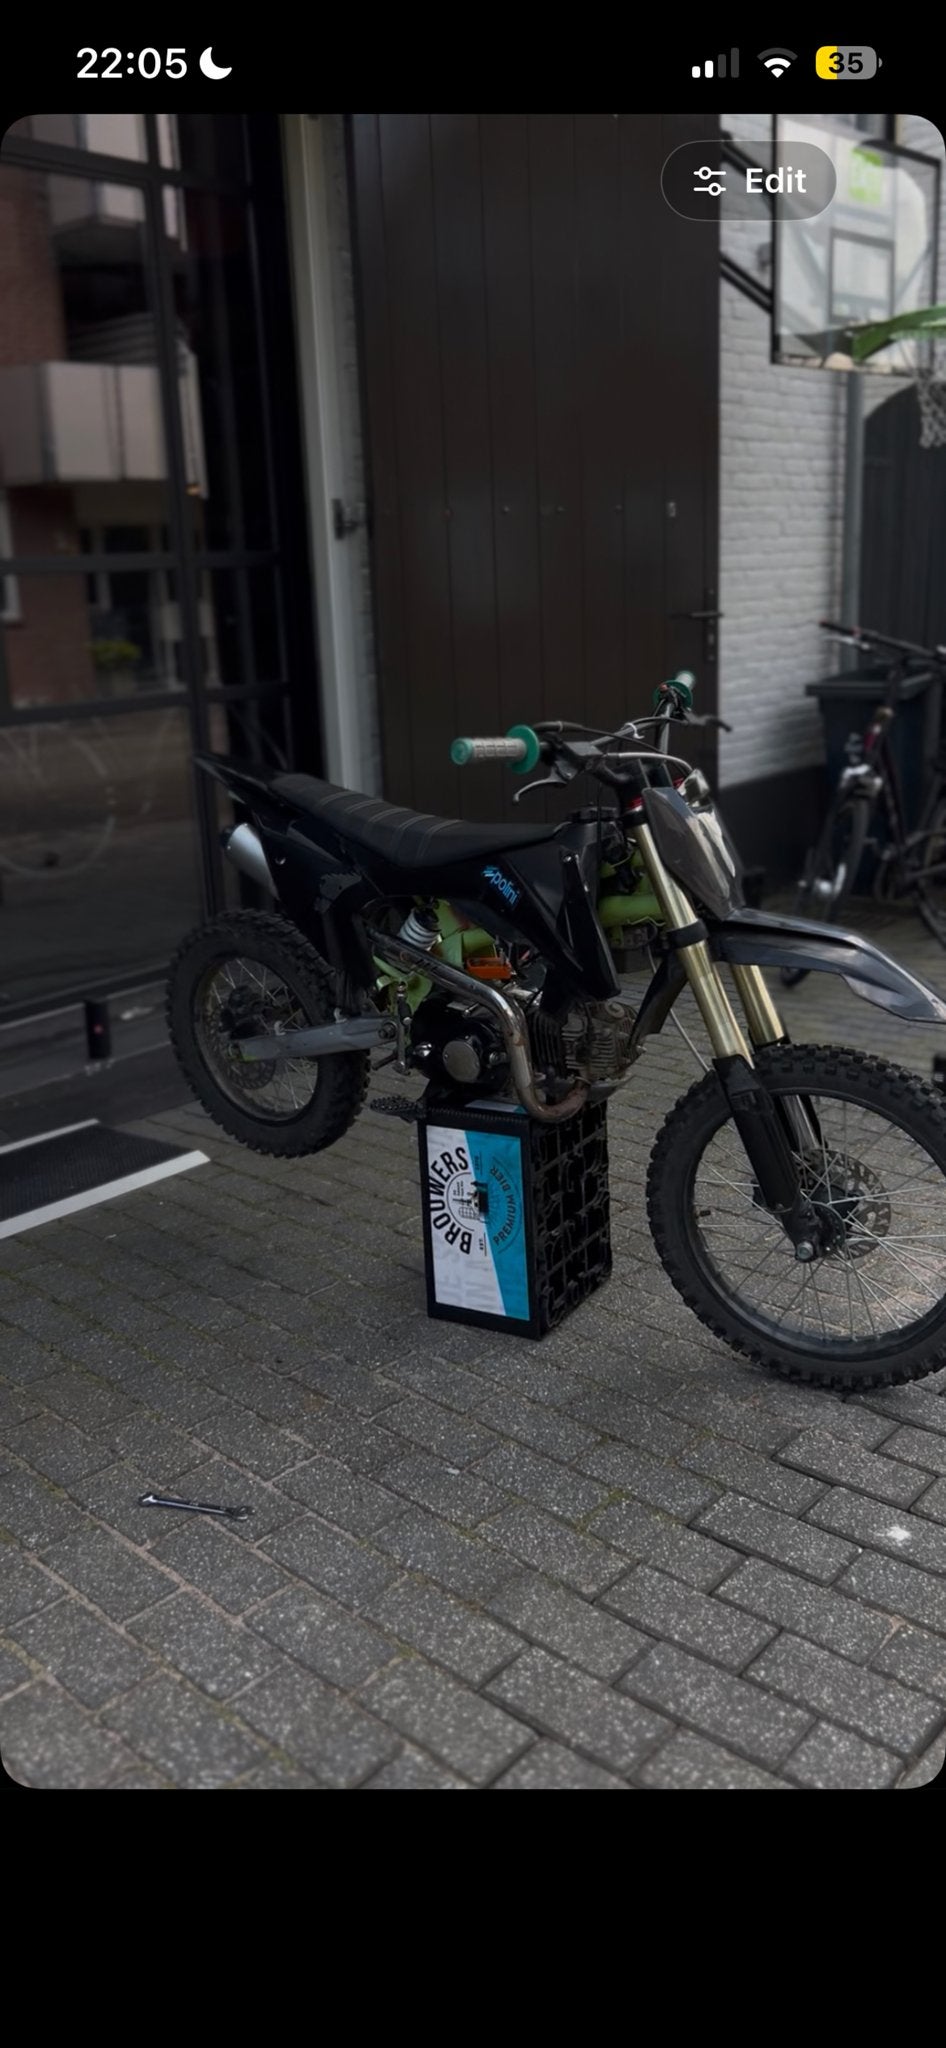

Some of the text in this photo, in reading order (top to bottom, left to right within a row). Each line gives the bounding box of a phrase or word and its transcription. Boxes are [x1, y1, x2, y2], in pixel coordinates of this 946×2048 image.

[489, 871, 520, 905] polini
[429, 1146, 472, 1255] BROUWERS
[490, 1165, 517, 1246] PREMIUM BIER
